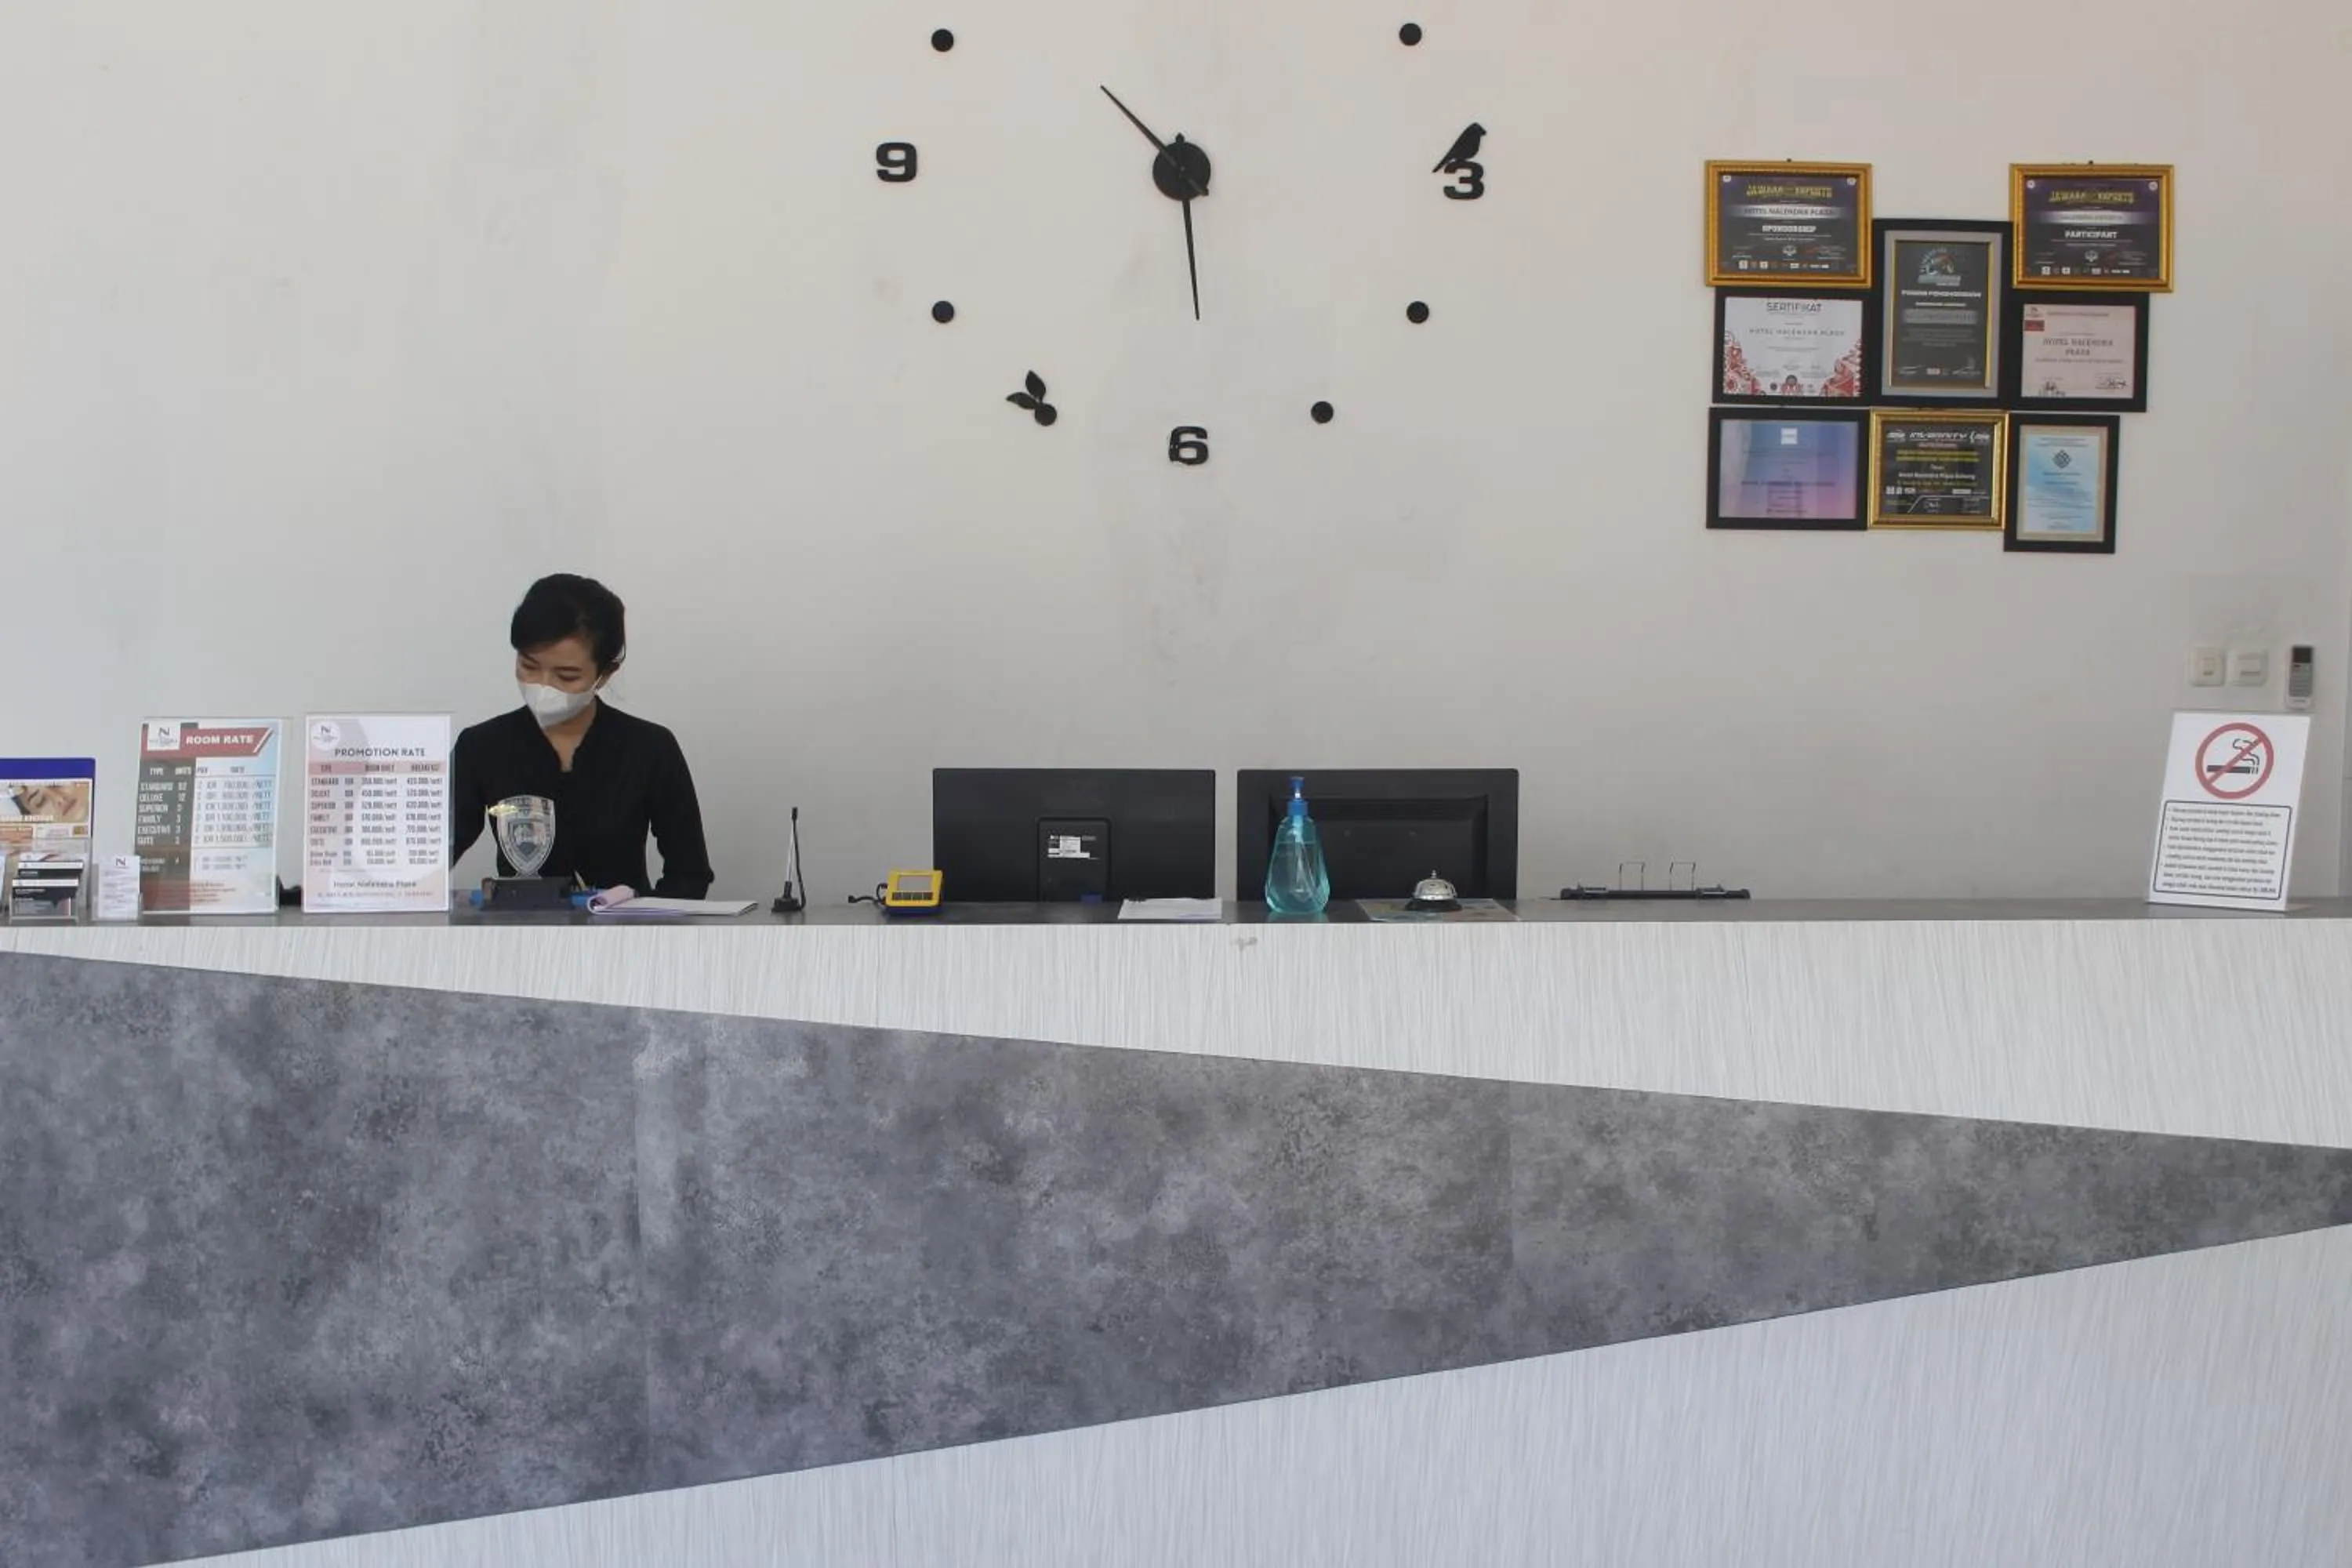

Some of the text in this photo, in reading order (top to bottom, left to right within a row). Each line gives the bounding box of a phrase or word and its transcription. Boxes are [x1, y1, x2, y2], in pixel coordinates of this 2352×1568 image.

[876, 142, 918, 182] 9
[1444, 160, 1485, 200] 3
[1168, 426, 1209, 466] 6
[159, 727, 170, 735] N
[186, 735, 254, 745] ROOM RATE
[335, 748, 425, 757] PROMOTION RATE
[115, 858, 126, 866] N
